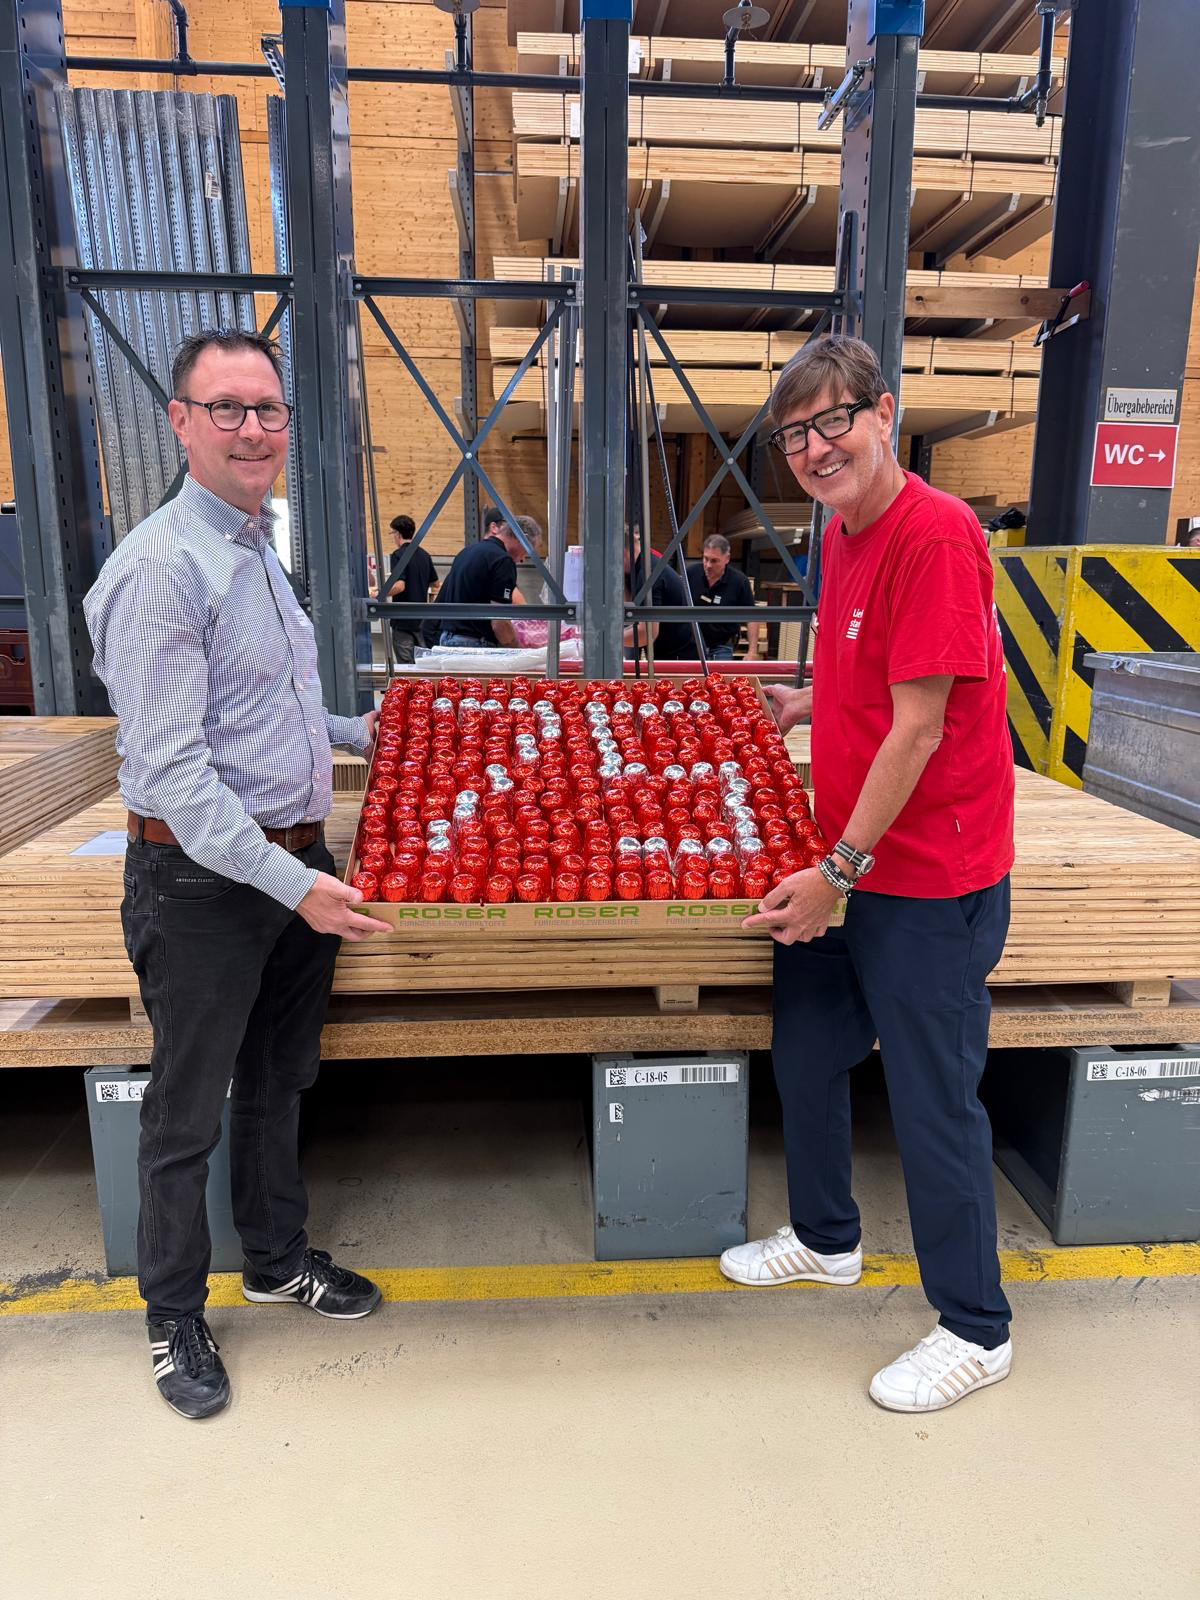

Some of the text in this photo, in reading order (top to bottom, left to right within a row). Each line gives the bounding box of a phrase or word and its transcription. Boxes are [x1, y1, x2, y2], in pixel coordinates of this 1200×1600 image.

[1107, 393, 1174, 417] Übergabebereich
[1104, 443, 1145, 465] WC
[399, 907, 507, 919] ROSER
[534, 905, 640, 919] ROSER
[634, 1071, 668, 1084] C-18-05
[1115, 1066, 1147, 1078] C-18-06
